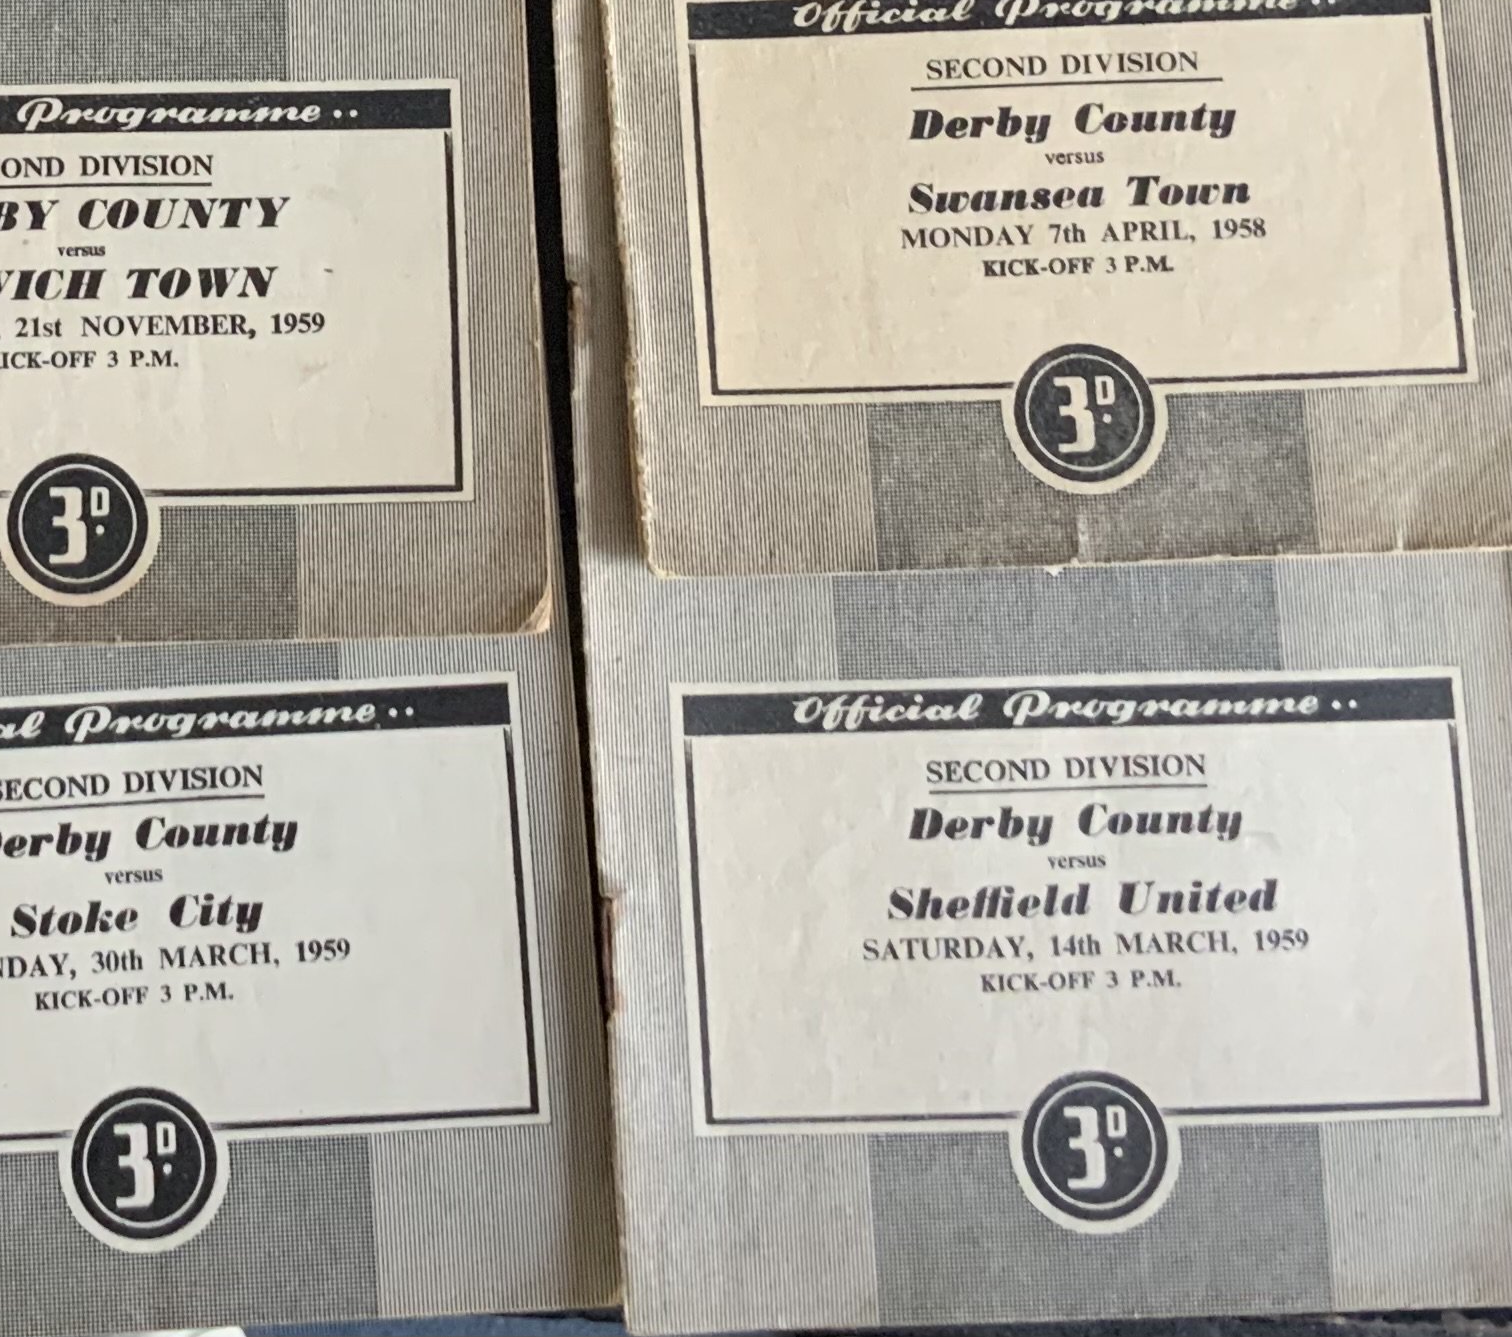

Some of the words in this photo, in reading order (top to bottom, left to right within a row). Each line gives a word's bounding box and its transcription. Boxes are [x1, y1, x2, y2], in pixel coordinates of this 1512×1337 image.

[926, 55, 1048, 80] SECOND
[1060, 51, 1198, 75] DIVISION
[909, 106, 1052, 144] Derby
[1074, 102, 1237, 139] County
[79, 154, 214, 177] DIVISION
[1044, 151, 1105, 166] versus
[908, 182, 1104, 214] Swansea
[1126, 175, 1251, 207] Town
[77, 196, 291, 230] COUNTY
[901, 224, 1033, 250] MONDAY
[1048, 222, 1087, 244] 7th
[1101, 219, 1196, 243] APRIL,
[1212, 217, 1267, 240] 1958
[57, 245, 106, 257] versus
[982, 256, 1095, 278] KICK-OFF
[1105, 256, 1118, 274] 3
[1124, 254, 1175, 273] P.M.
[126, 266, 278, 299] TOWN
[15, 316, 63, 338] 21st
[81, 313, 257, 340] NOVEMBER,
[271, 312, 326, 335] 1959
[107, 350, 119, 368] 3
[129, 349, 179, 368] P.M.
[792, 693, 984, 731] Official
[123, 764, 263, 795] DIVISION
[926, 758, 1051, 785] SECOND
[1064, 753, 1206, 779] DIVISION
[135, 814, 298, 853] County
[908, 806, 1054, 847] Derby
[1078, 803, 1243, 842] County
[104, 868, 164, 885] versus
[1047, 855, 1107, 870] versus
[10, 900, 139, 938] Stoke
[169, 893, 263, 934] City
[887, 883, 1090, 921] Sheffield
[1118, 878, 1278, 915] United
[91, 948, 144, 974] 30th
[159, 941, 280, 970] MARCH,
[297, 938, 351, 963] 1959
[863, 935, 1034, 962] SATURDAY,
[1050, 933, 1102, 957] 14th
[1116, 930, 1238, 955] MARCH,
[1255, 928, 1310, 952] 1959
[35, 986, 149, 1011] KICK-OFF
[160, 984, 172, 1004] 3
[183, 981, 234, 1002] P.M.
[980, 970, 1095, 993] KICK-OFF
[1106, 970, 1119, 989] 3
[1130, 969, 1182, 989] P.M.
